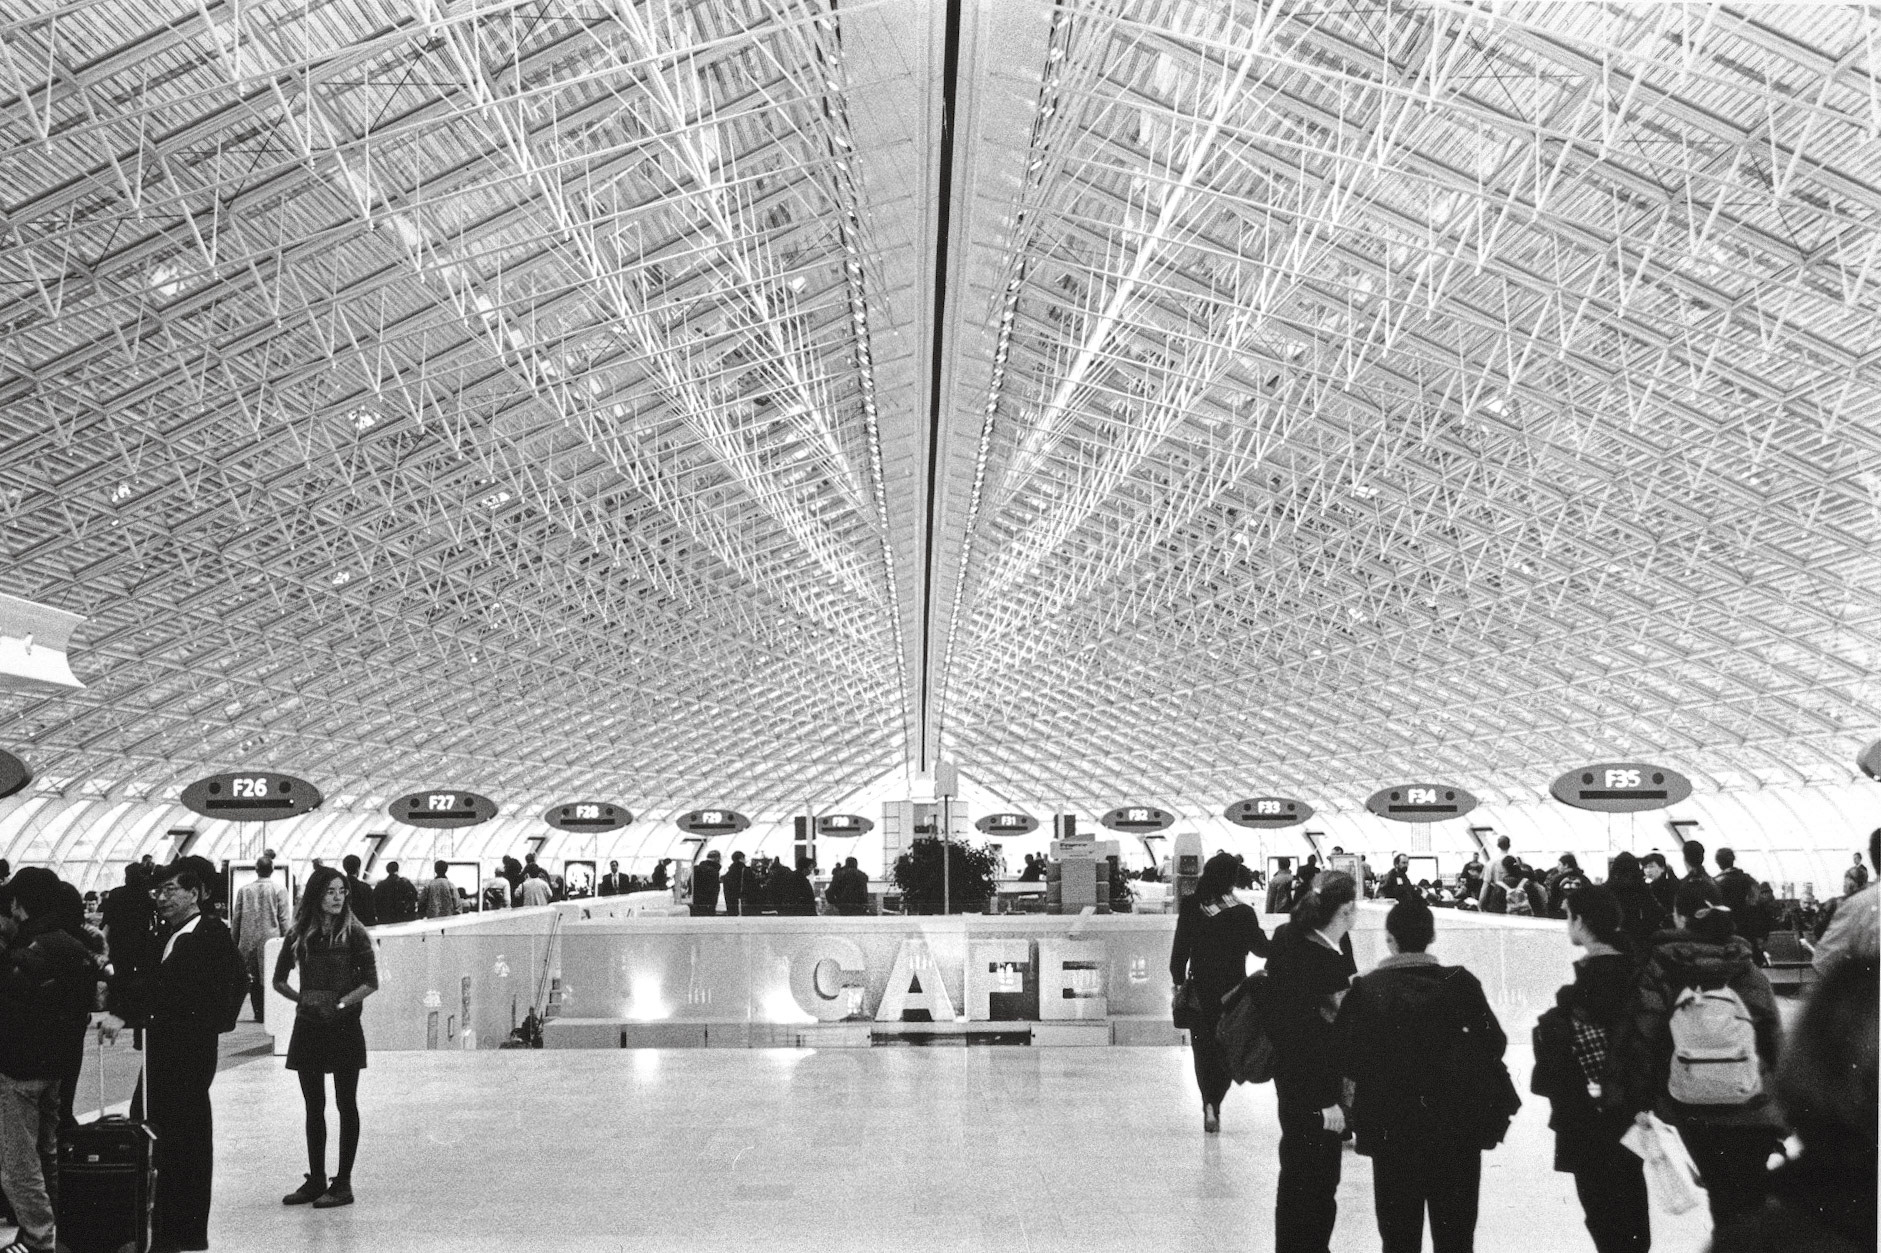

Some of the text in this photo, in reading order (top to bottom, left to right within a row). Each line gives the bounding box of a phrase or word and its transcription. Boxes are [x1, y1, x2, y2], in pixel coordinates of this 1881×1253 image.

[1605, 769, 1641, 788] F35
[233, 778, 268, 797] F26
[429, 795, 456, 810] F27
[1407, 788, 1437, 804] F34
[1257, 800, 1281, 814] F33
[1001, 815, 1017, 826] F31
